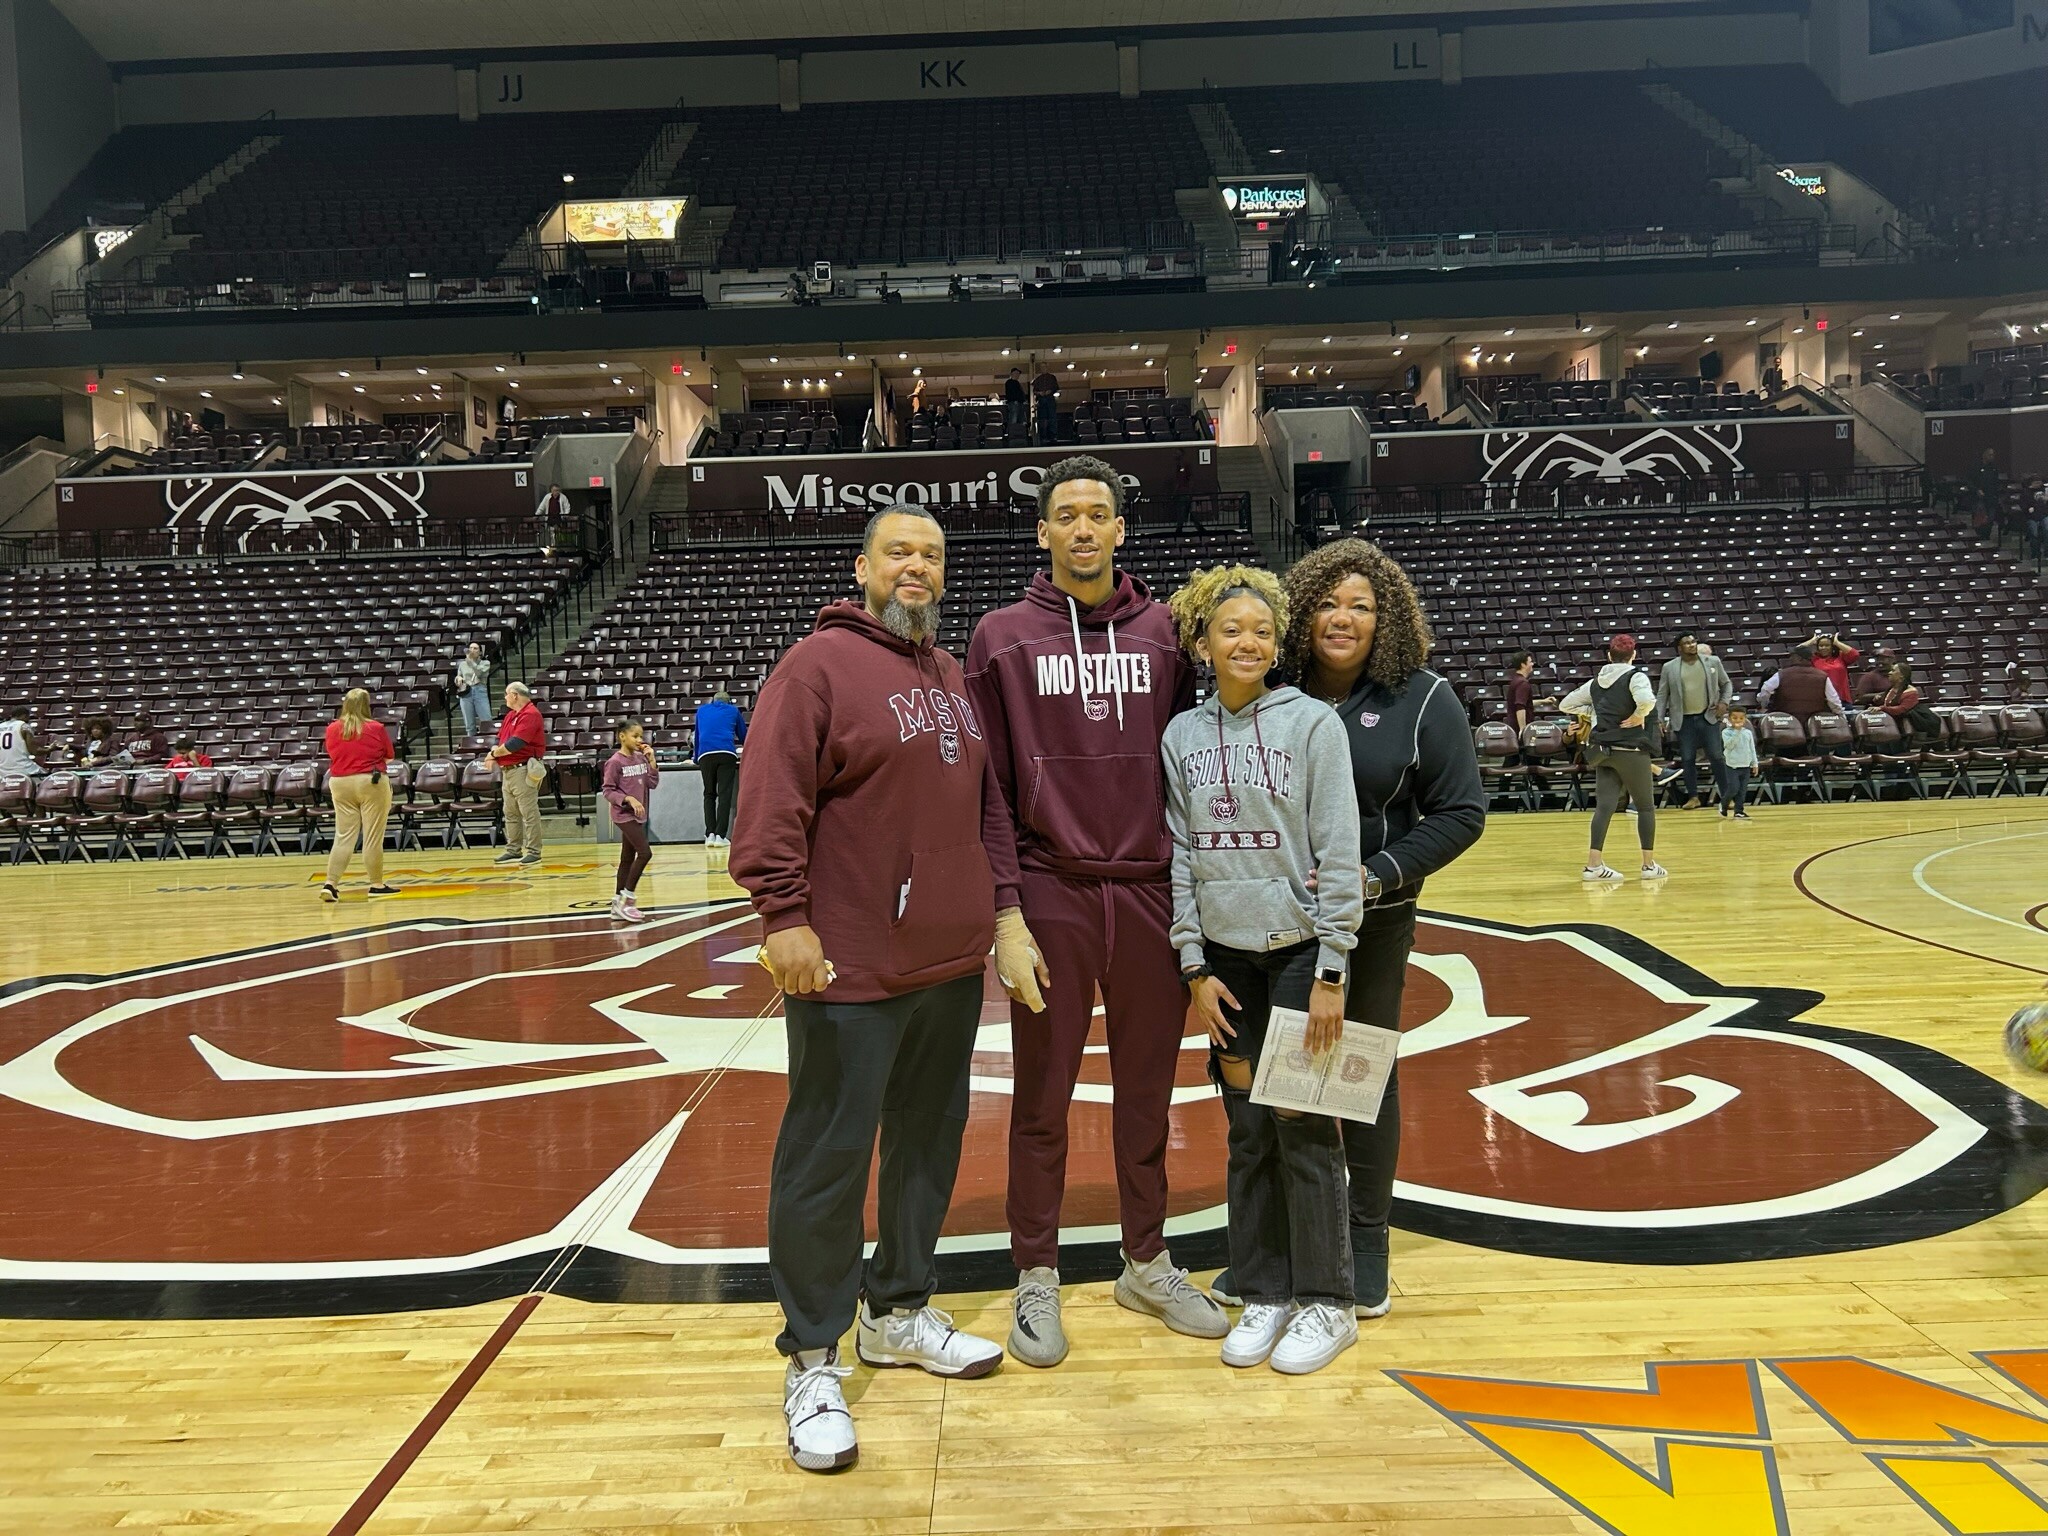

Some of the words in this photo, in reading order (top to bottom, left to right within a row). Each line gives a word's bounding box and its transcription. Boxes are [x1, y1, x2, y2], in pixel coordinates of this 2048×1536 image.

[1393, 42, 1428, 69] LL
[920, 60, 967, 88] KK
[499, 74, 522, 102] JJ
[1240, 187, 1305, 202] Parkcrest
[1240, 201, 1274, 211] DENTAL
[1275, 200, 1306, 210] GROUP
[1933, 422, 1942, 432] N
[1378, 444, 1387, 454] M
[517, 474, 525, 484] K
[64, 489, 72, 499] K
[763, 472, 998, 523] Missouri
[1037, 655, 1074, 696] MO
[1083, 653, 1143, 695] STATE
[1140, 653, 1151, 694] HOOPS
[889, 688, 982, 741] MSU
[1243, 742, 1294, 799] STATE
